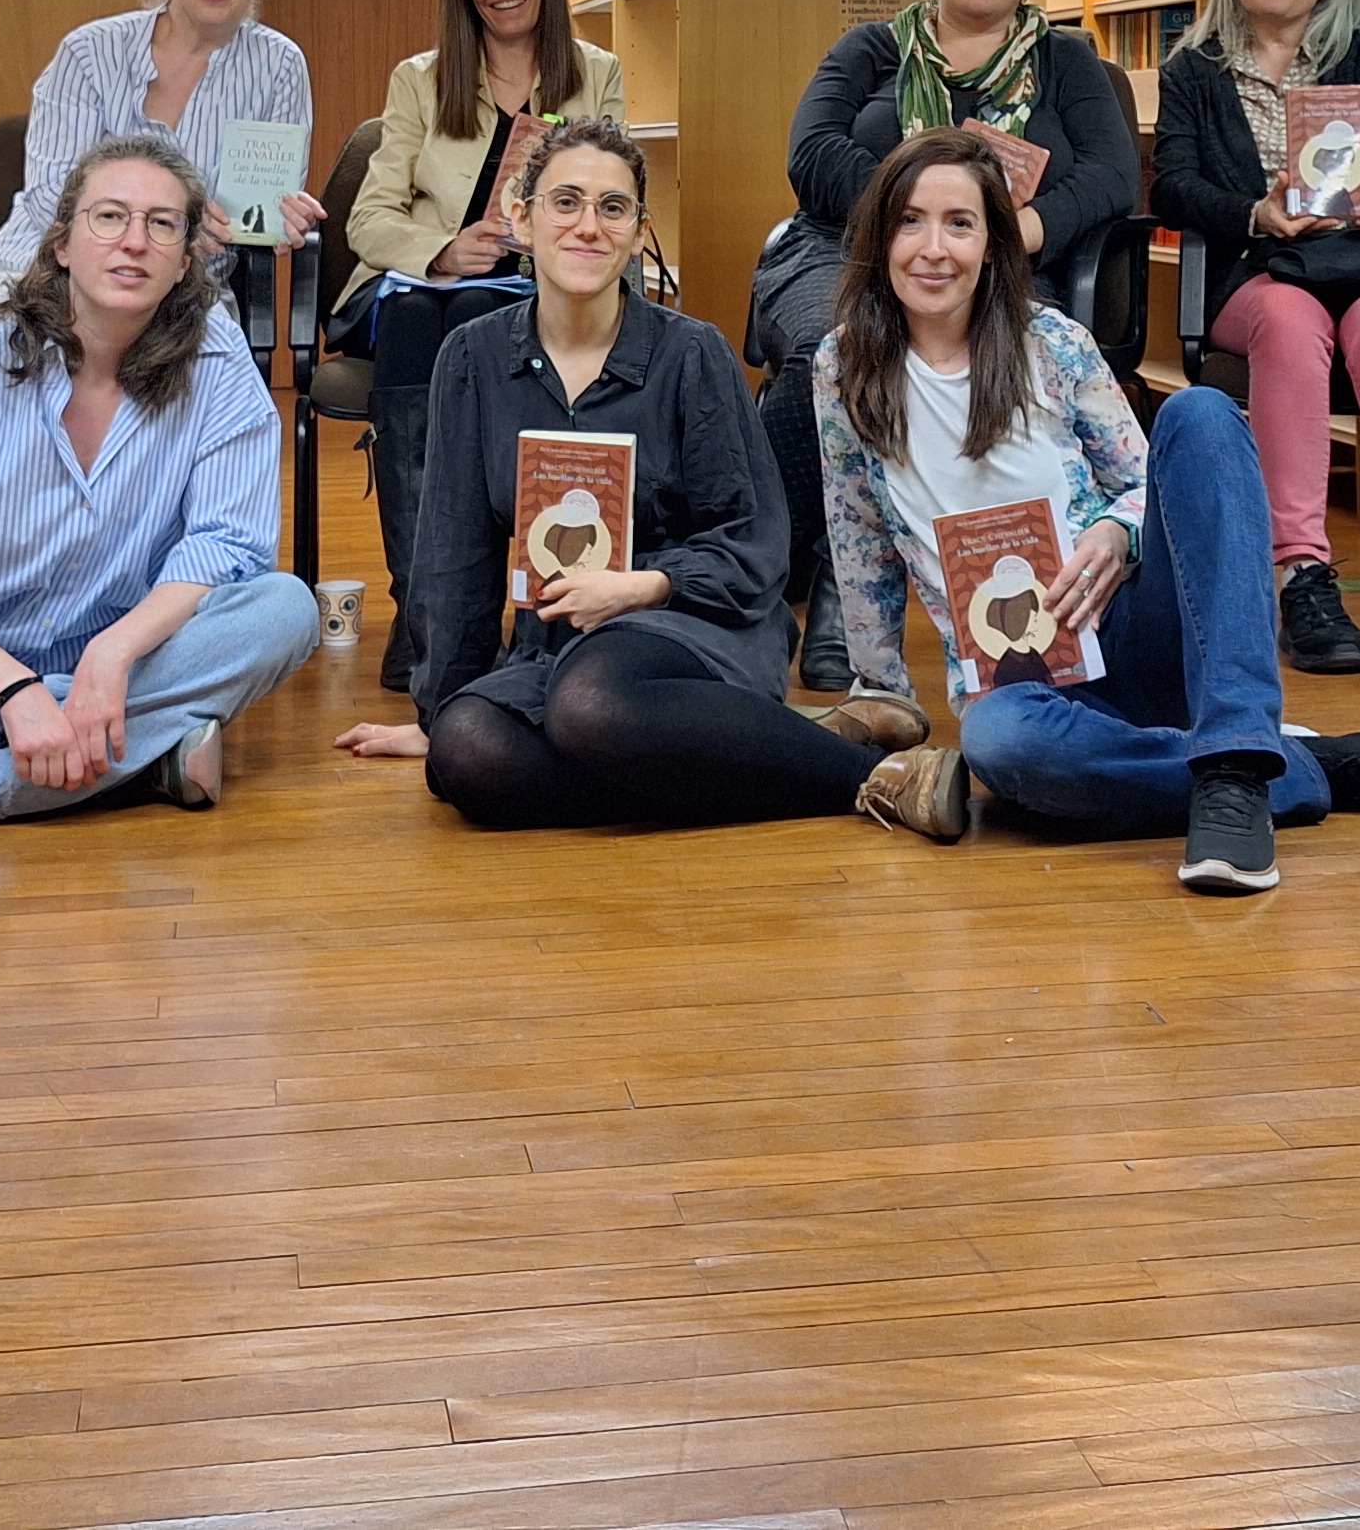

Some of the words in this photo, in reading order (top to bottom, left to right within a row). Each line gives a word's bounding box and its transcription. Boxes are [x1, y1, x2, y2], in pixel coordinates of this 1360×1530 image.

[245, 139, 284, 151] TRACY
[228, 149, 295, 162] CHEVALIER
[233, 162, 249, 172] Las
[253, 161, 290, 174] huellas
[234, 173, 247, 184] de
[251, 175, 260, 185] la
[263, 176, 285, 187] vida
[533, 470, 547, 480] Las
[548, 472, 575, 482] huellas
[575, 475, 586, 483] de
[586, 476, 595, 484] la
[595, 477, 614, 485] vida
[961, 534, 987, 546] TRACY
[988, 524, 1031, 541] CHEVALIER
[957, 548, 972, 558] Las
[971, 543, 1000, 555] huellas
[1001, 540, 1011, 550] de
[1012, 538, 1020, 547] la
[1021, 535, 1040, 545] vida
